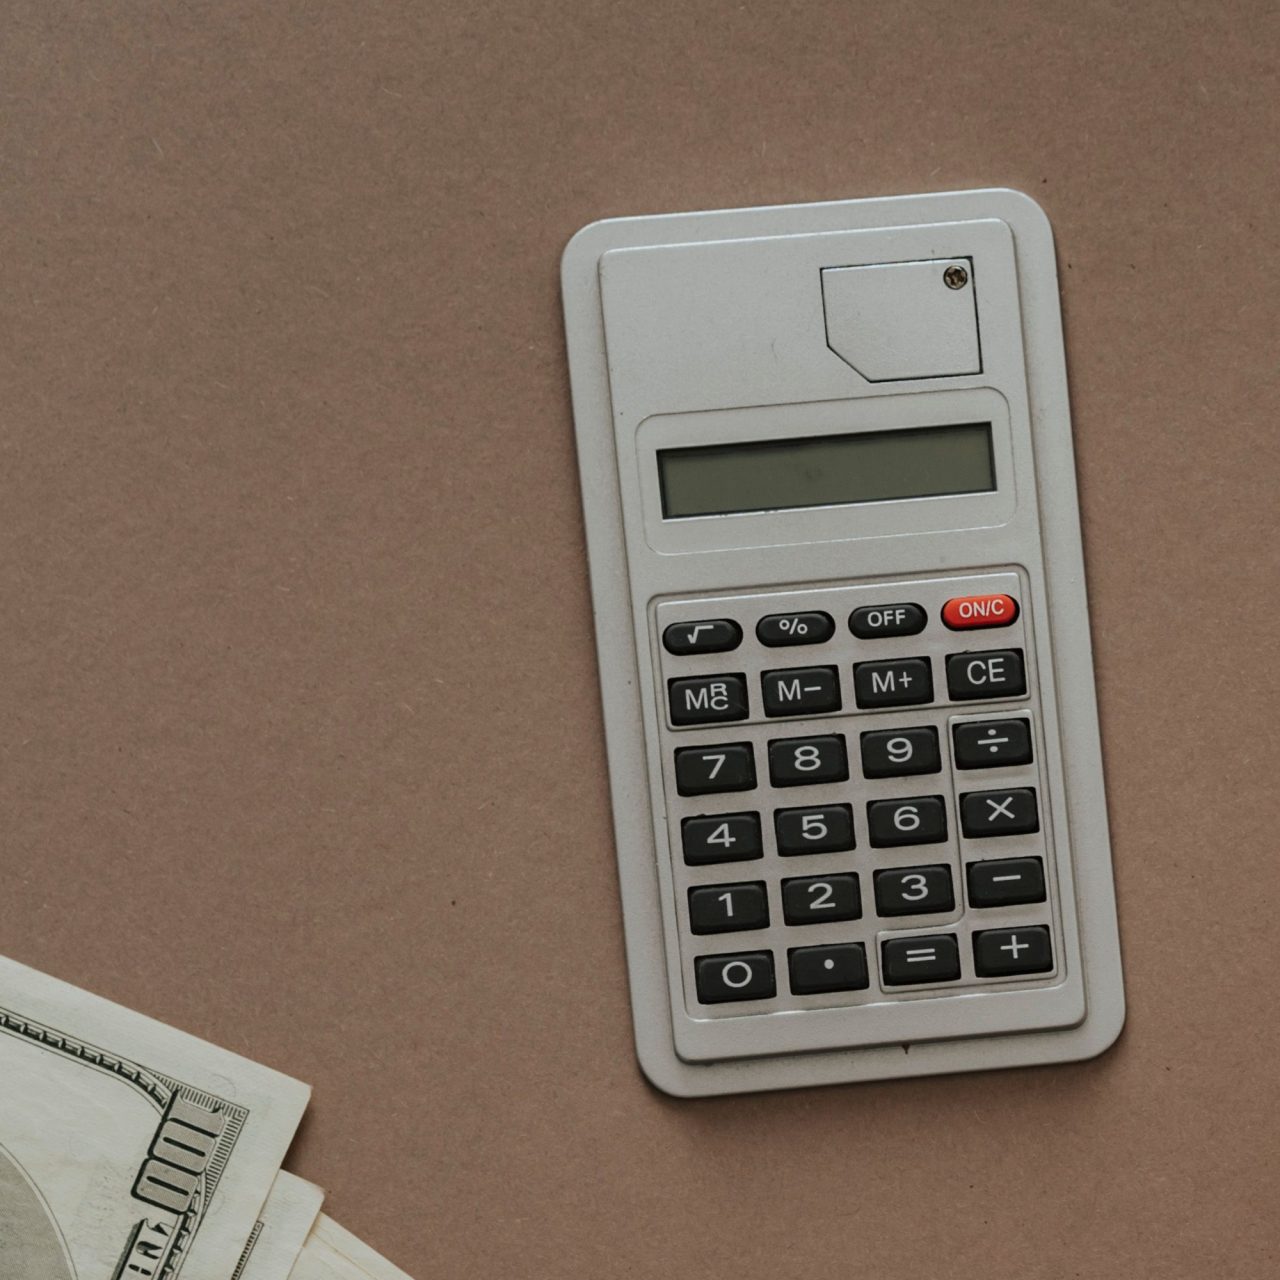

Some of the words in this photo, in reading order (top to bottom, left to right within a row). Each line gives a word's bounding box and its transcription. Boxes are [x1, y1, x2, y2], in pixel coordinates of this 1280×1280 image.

[866, 609, 906, 627] OFF
[959, 600, 1004, 618] ON/C
[872, 671, 912, 693] M+
[967, 658, 1005, 684] CE
[703, 755, 725, 779] 7
[795, 746, 820, 770] 8
[887, 738, 912, 762] 9
[707, 823, 736, 847] 4
[803, 815, 827, 839] 5
[894, 806, 919, 830] 6
[719, 893, 733, 916] 1
[808, 883, 835, 909] 2
[902, 875, 928, 900] 3
[128, 1088, 229, 1219] 100
